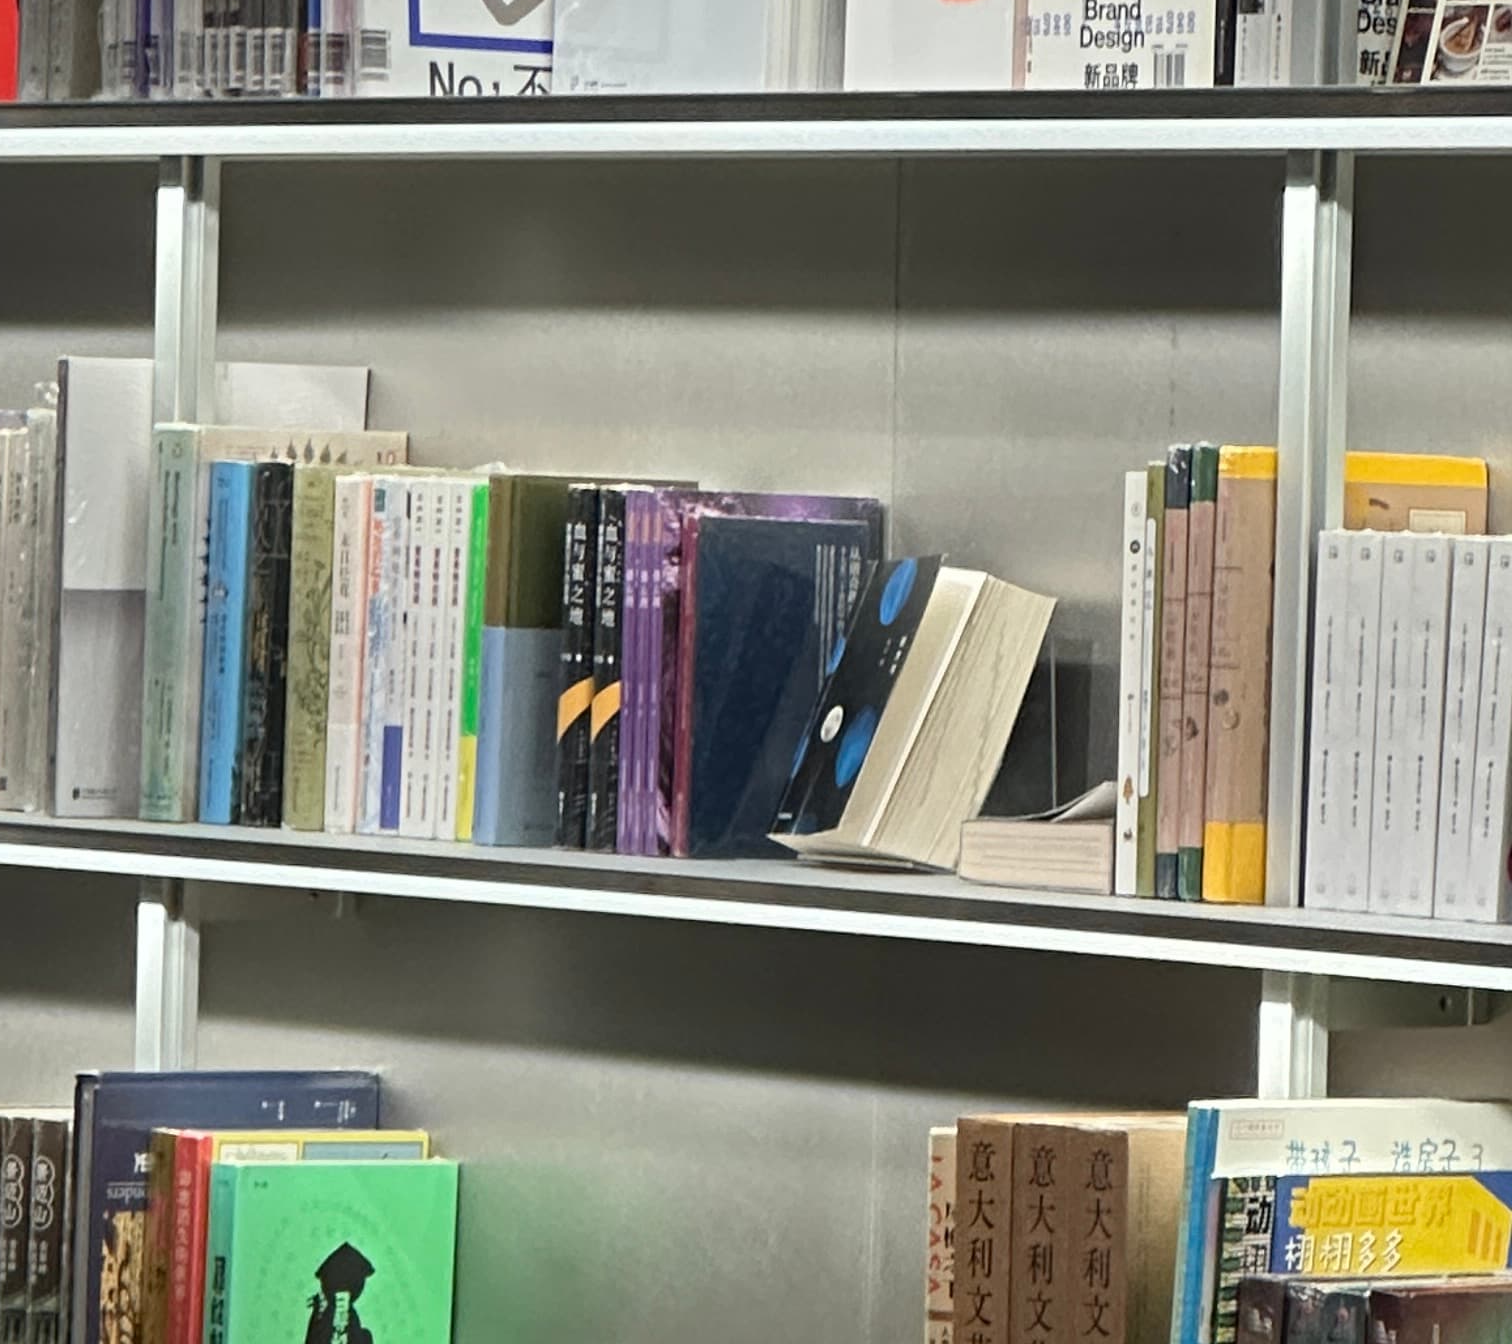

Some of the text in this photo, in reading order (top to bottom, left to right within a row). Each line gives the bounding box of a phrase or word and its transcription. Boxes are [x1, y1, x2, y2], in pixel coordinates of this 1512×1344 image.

[1079, 21, 1145, 54] Design
[1084, 62, 1139, 88] 新品牌
